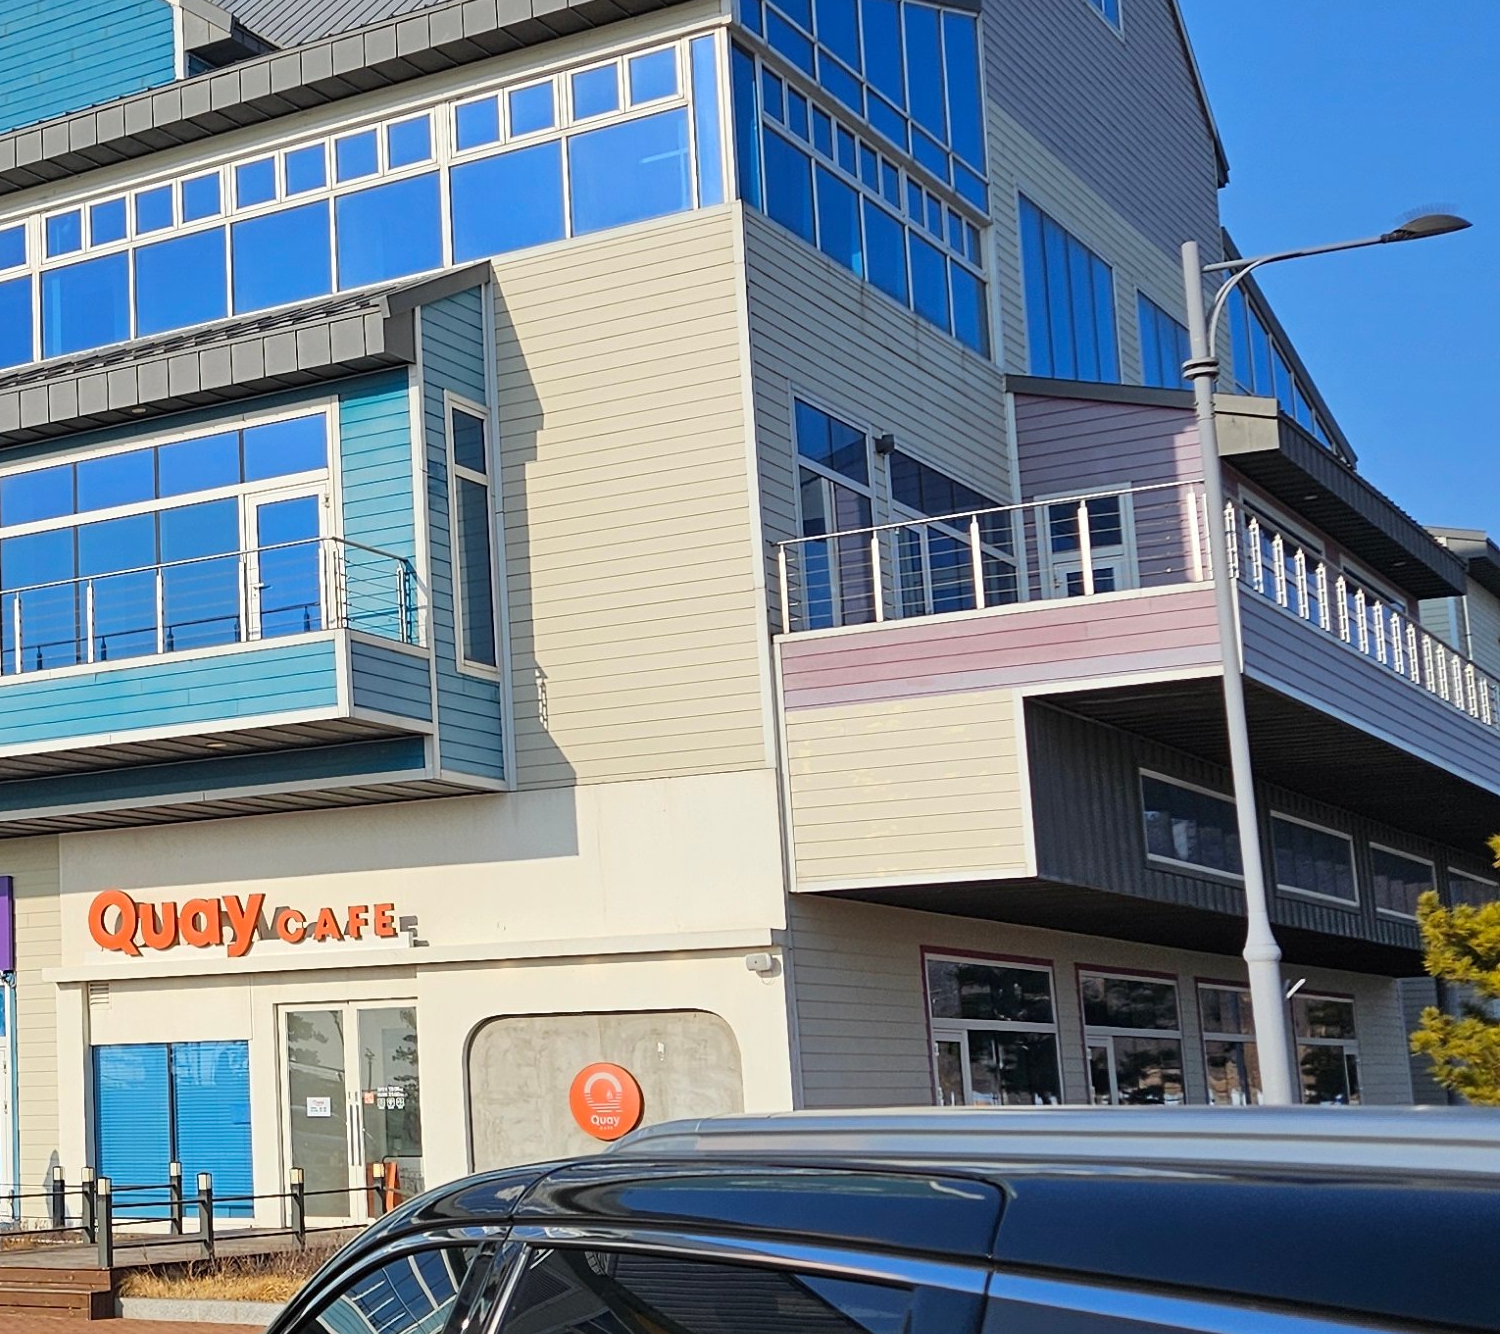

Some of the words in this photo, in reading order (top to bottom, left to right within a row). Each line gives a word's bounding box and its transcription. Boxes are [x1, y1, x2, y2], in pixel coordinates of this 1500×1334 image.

[88, 890, 266, 957] Quay
[277, 903, 398, 944] CAFE
[590, 1114, 620, 1127] Quay
